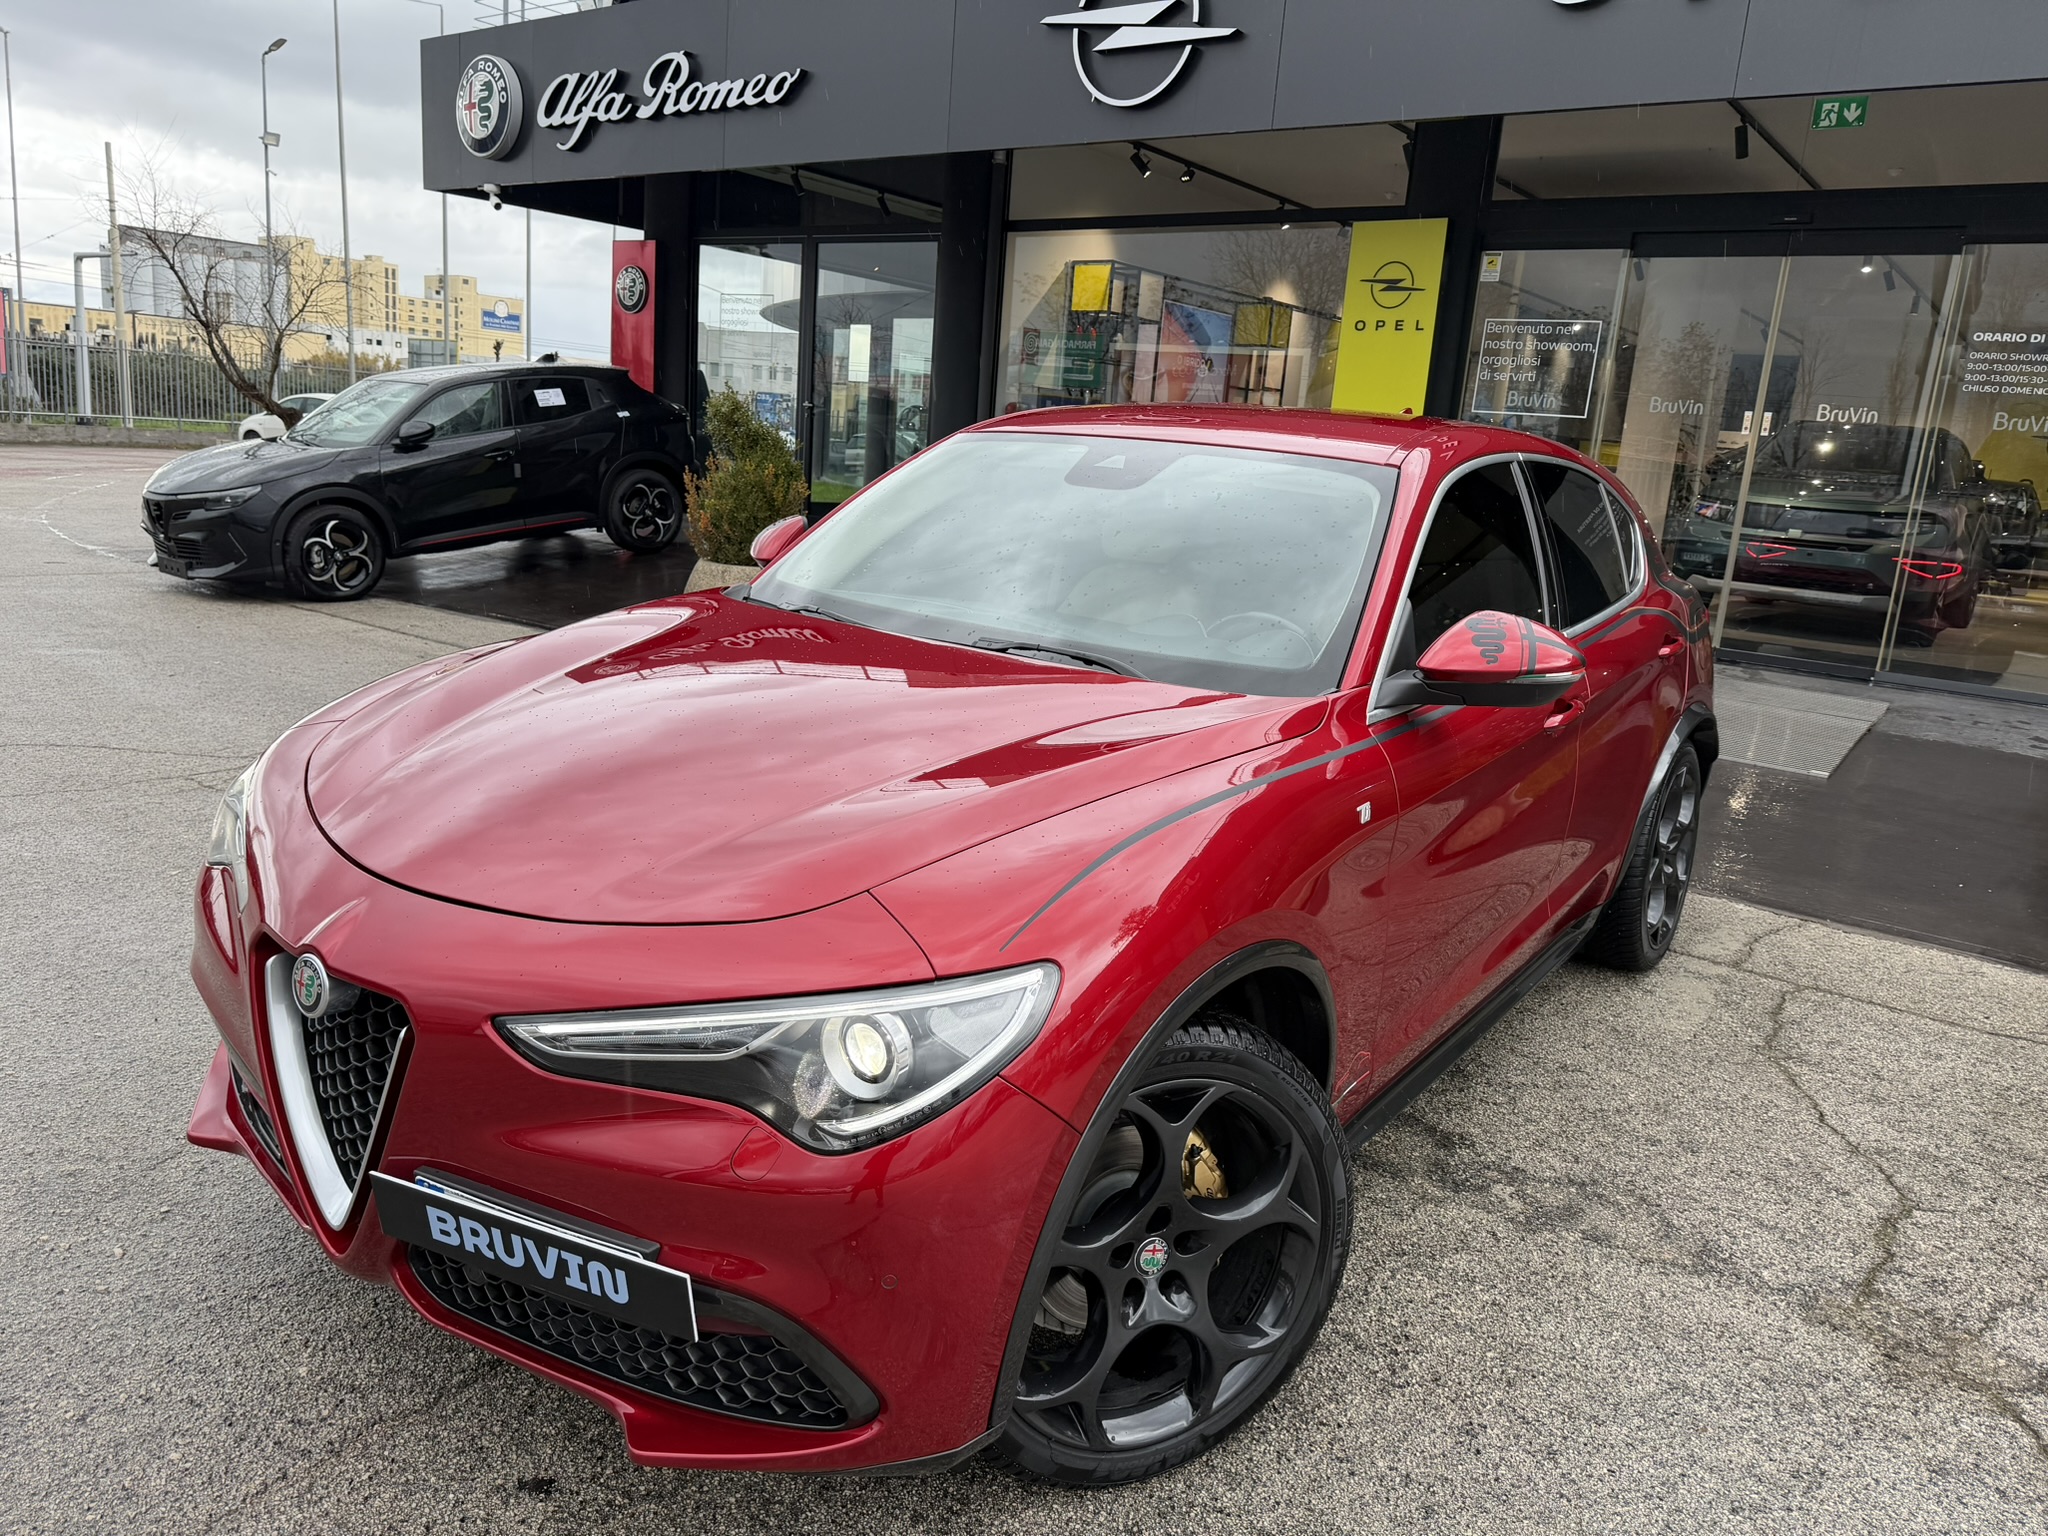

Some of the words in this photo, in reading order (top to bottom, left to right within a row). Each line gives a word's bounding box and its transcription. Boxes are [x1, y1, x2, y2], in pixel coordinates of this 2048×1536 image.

[478, 61, 507, 104] ROMEO
[536, 68, 632, 150] Alfa
[635, 50, 801, 119] Romeo
[1354, 320, 1424, 331] OPEL
[1487, 322, 1553, 335] Benvenuto
[1555, 323, 1575, 335] nel
[1973, 332, 2027, 343] ORARIO
[2030, 333, 2046, 343] DI
[1484, 340, 1523, 350] nostro
[1526, 339, 1596, 354] showroom,
[1481, 355, 1541, 368] orgogliosi
[1969, 351, 2008, 360] ORARIO
[1480, 369, 1491, 380] di
[1494, 370, 1537, 382] servirti
[1962, 384, 2000, 393] CHIUSO
[1507, 390, 1557, 409] BruVin
[1649, 396, 1704, 416] BruVin
[1816, 404, 1879, 424] BruVin
[1281, 1077, 1313, 1107] ROTATION
[425, 1205, 629, 1304] BRUVIN
